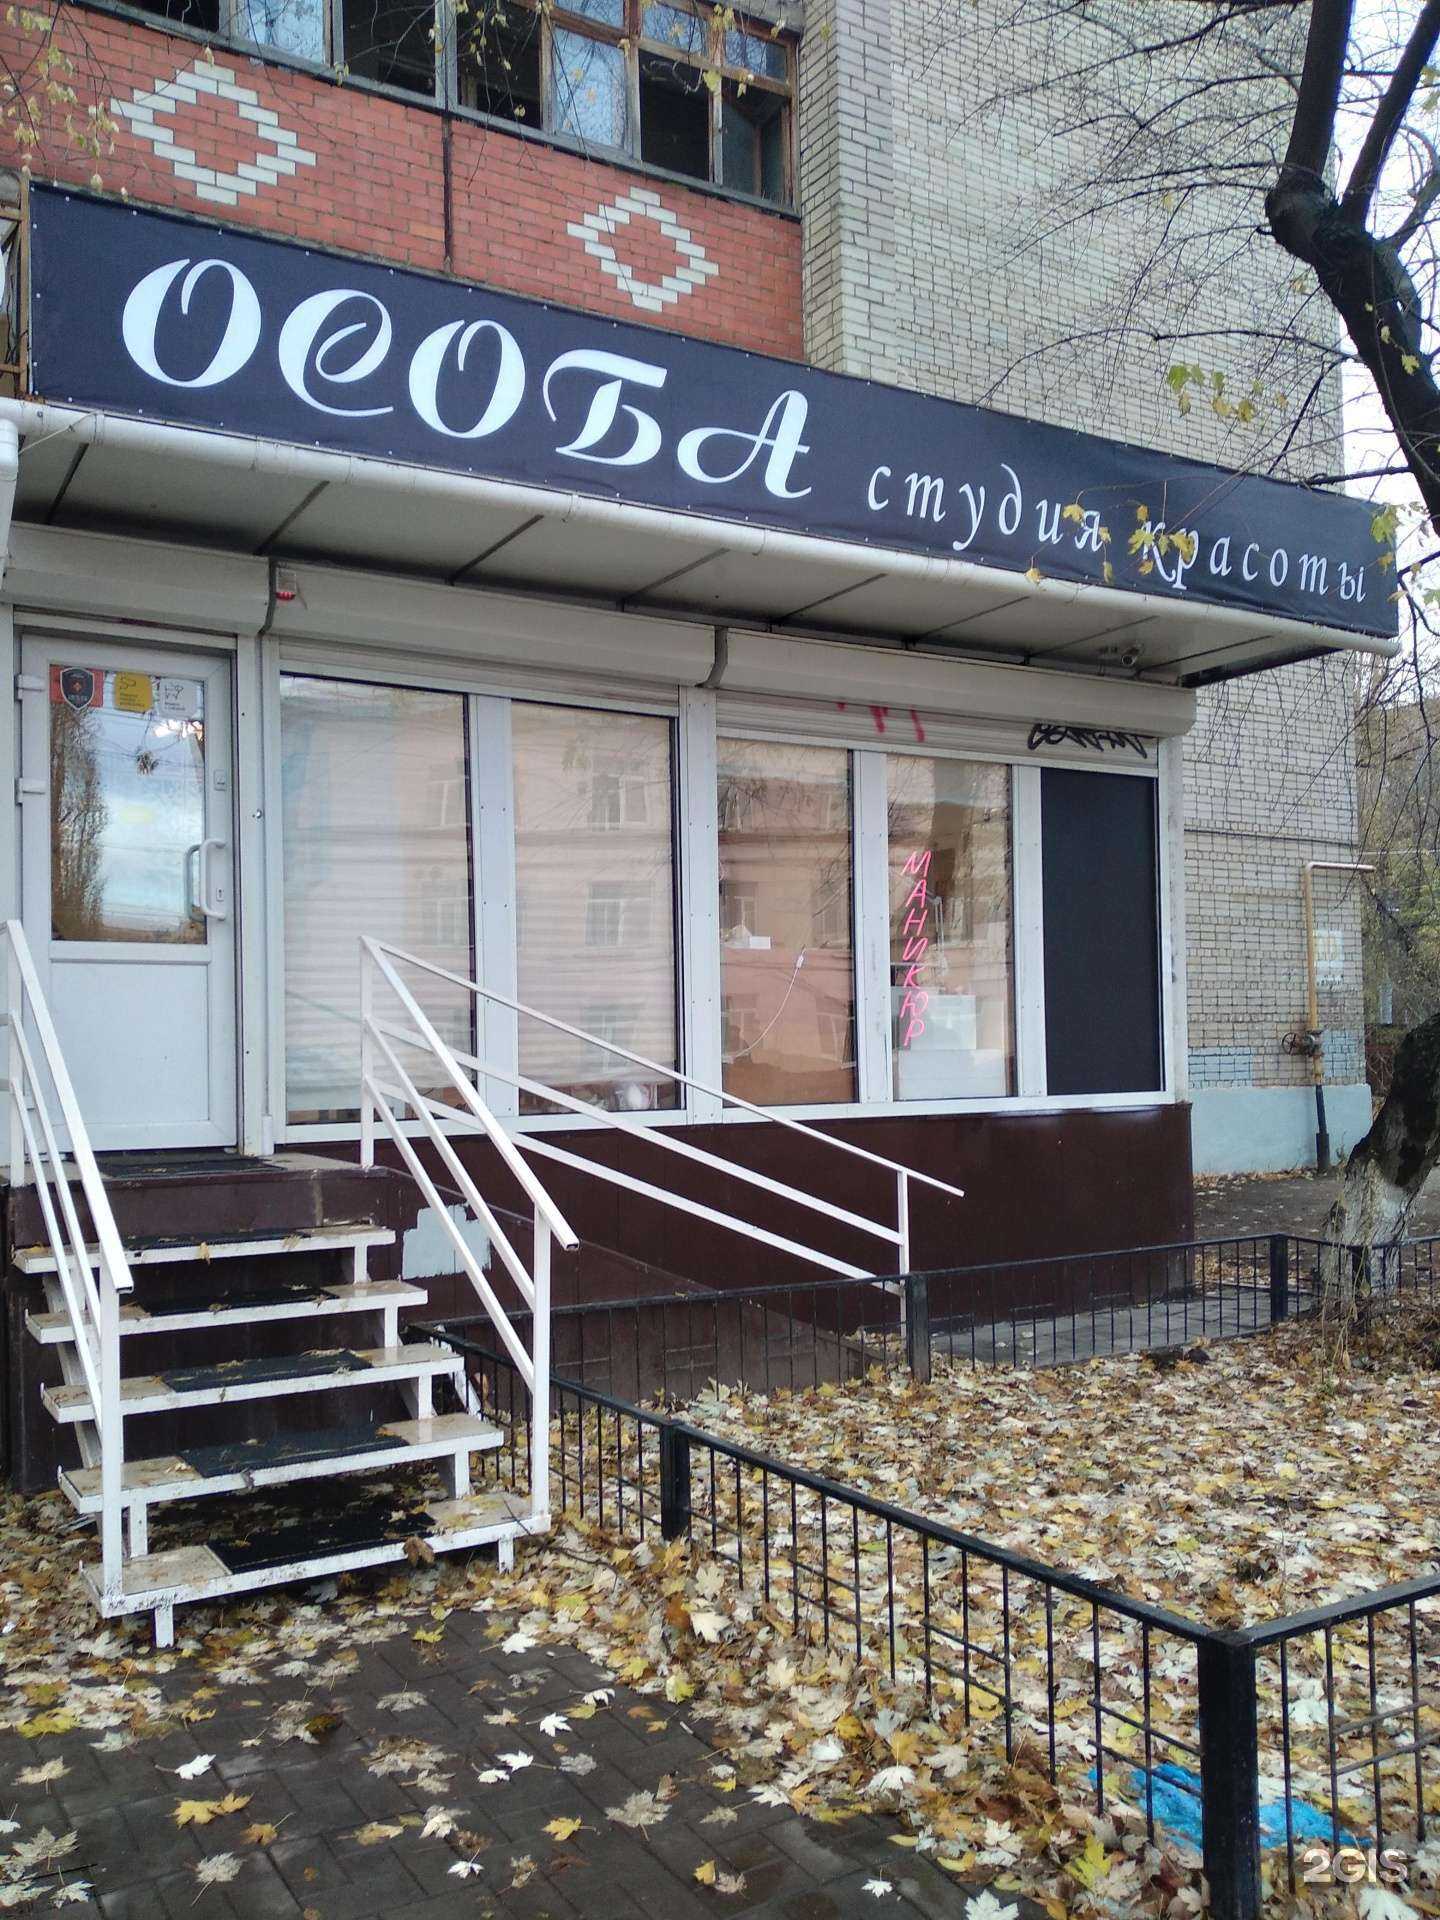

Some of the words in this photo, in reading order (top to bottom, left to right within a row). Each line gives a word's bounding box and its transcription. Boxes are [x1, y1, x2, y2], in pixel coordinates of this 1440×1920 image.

[123, 258, 812, 499] ОСОБА
[867, 463, 1104, 553] студия
[1141, 520, 1367, 603] красоты
[901, 851, 932, 1047] МАНИКЮР
